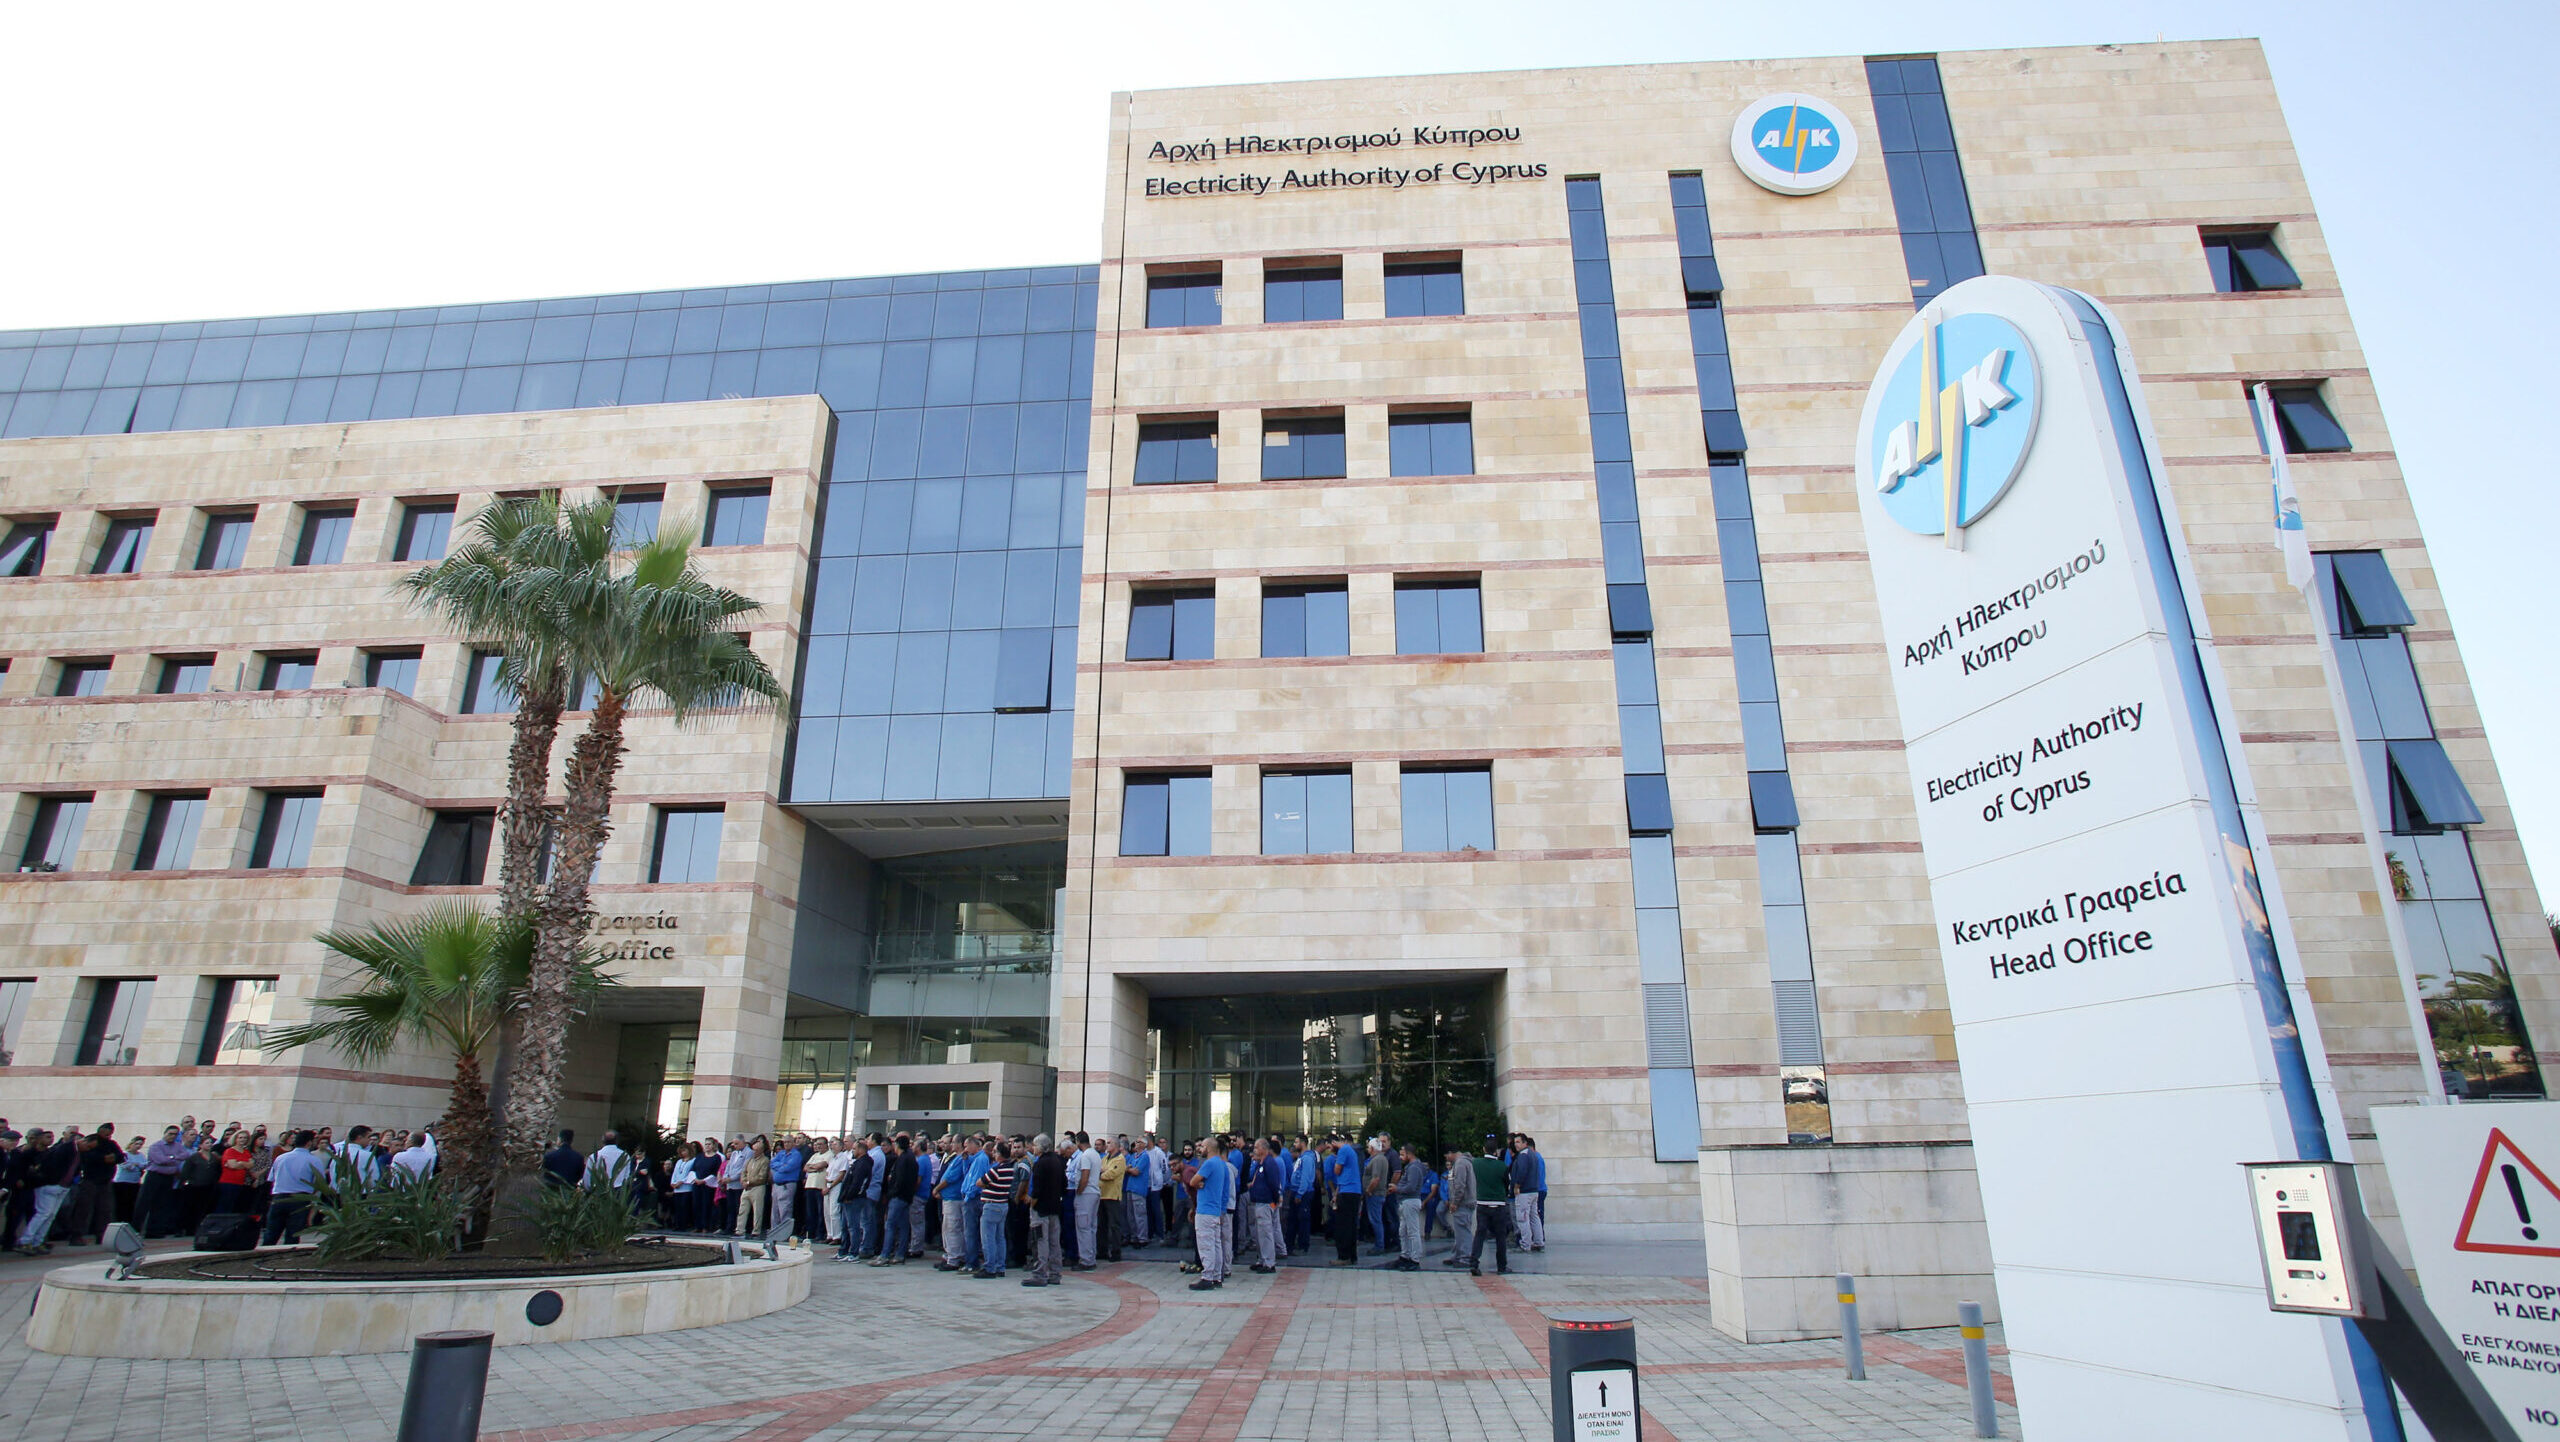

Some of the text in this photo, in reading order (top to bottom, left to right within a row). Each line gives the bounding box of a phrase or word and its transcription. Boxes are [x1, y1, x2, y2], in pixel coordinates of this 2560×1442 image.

[1148, 125, 1520, 163] Αρχή Ηλεκτρισμού Κύπρου
[1145, 161, 1548, 197] Electricity Authority of Cyprus
[1904, 539, 2106, 667] Αρχή Ηλεκτρισμού
[1961, 619, 2048, 676] Κύπρου
[1926, 702, 2143, 802] Electricity Authority
[1982, 770, 2091, 822] of Cyprus
[1952, 871, 2187, 945] Κεντρικά Γραφεία
[600, 939, 675, 960] Office
[1989, 929, 2153, 979] Head Office
[2494, 1301, 2510, 1317] Η
[2487, 1353, 2560, 1374] ΑΝΑΔΥΟ
